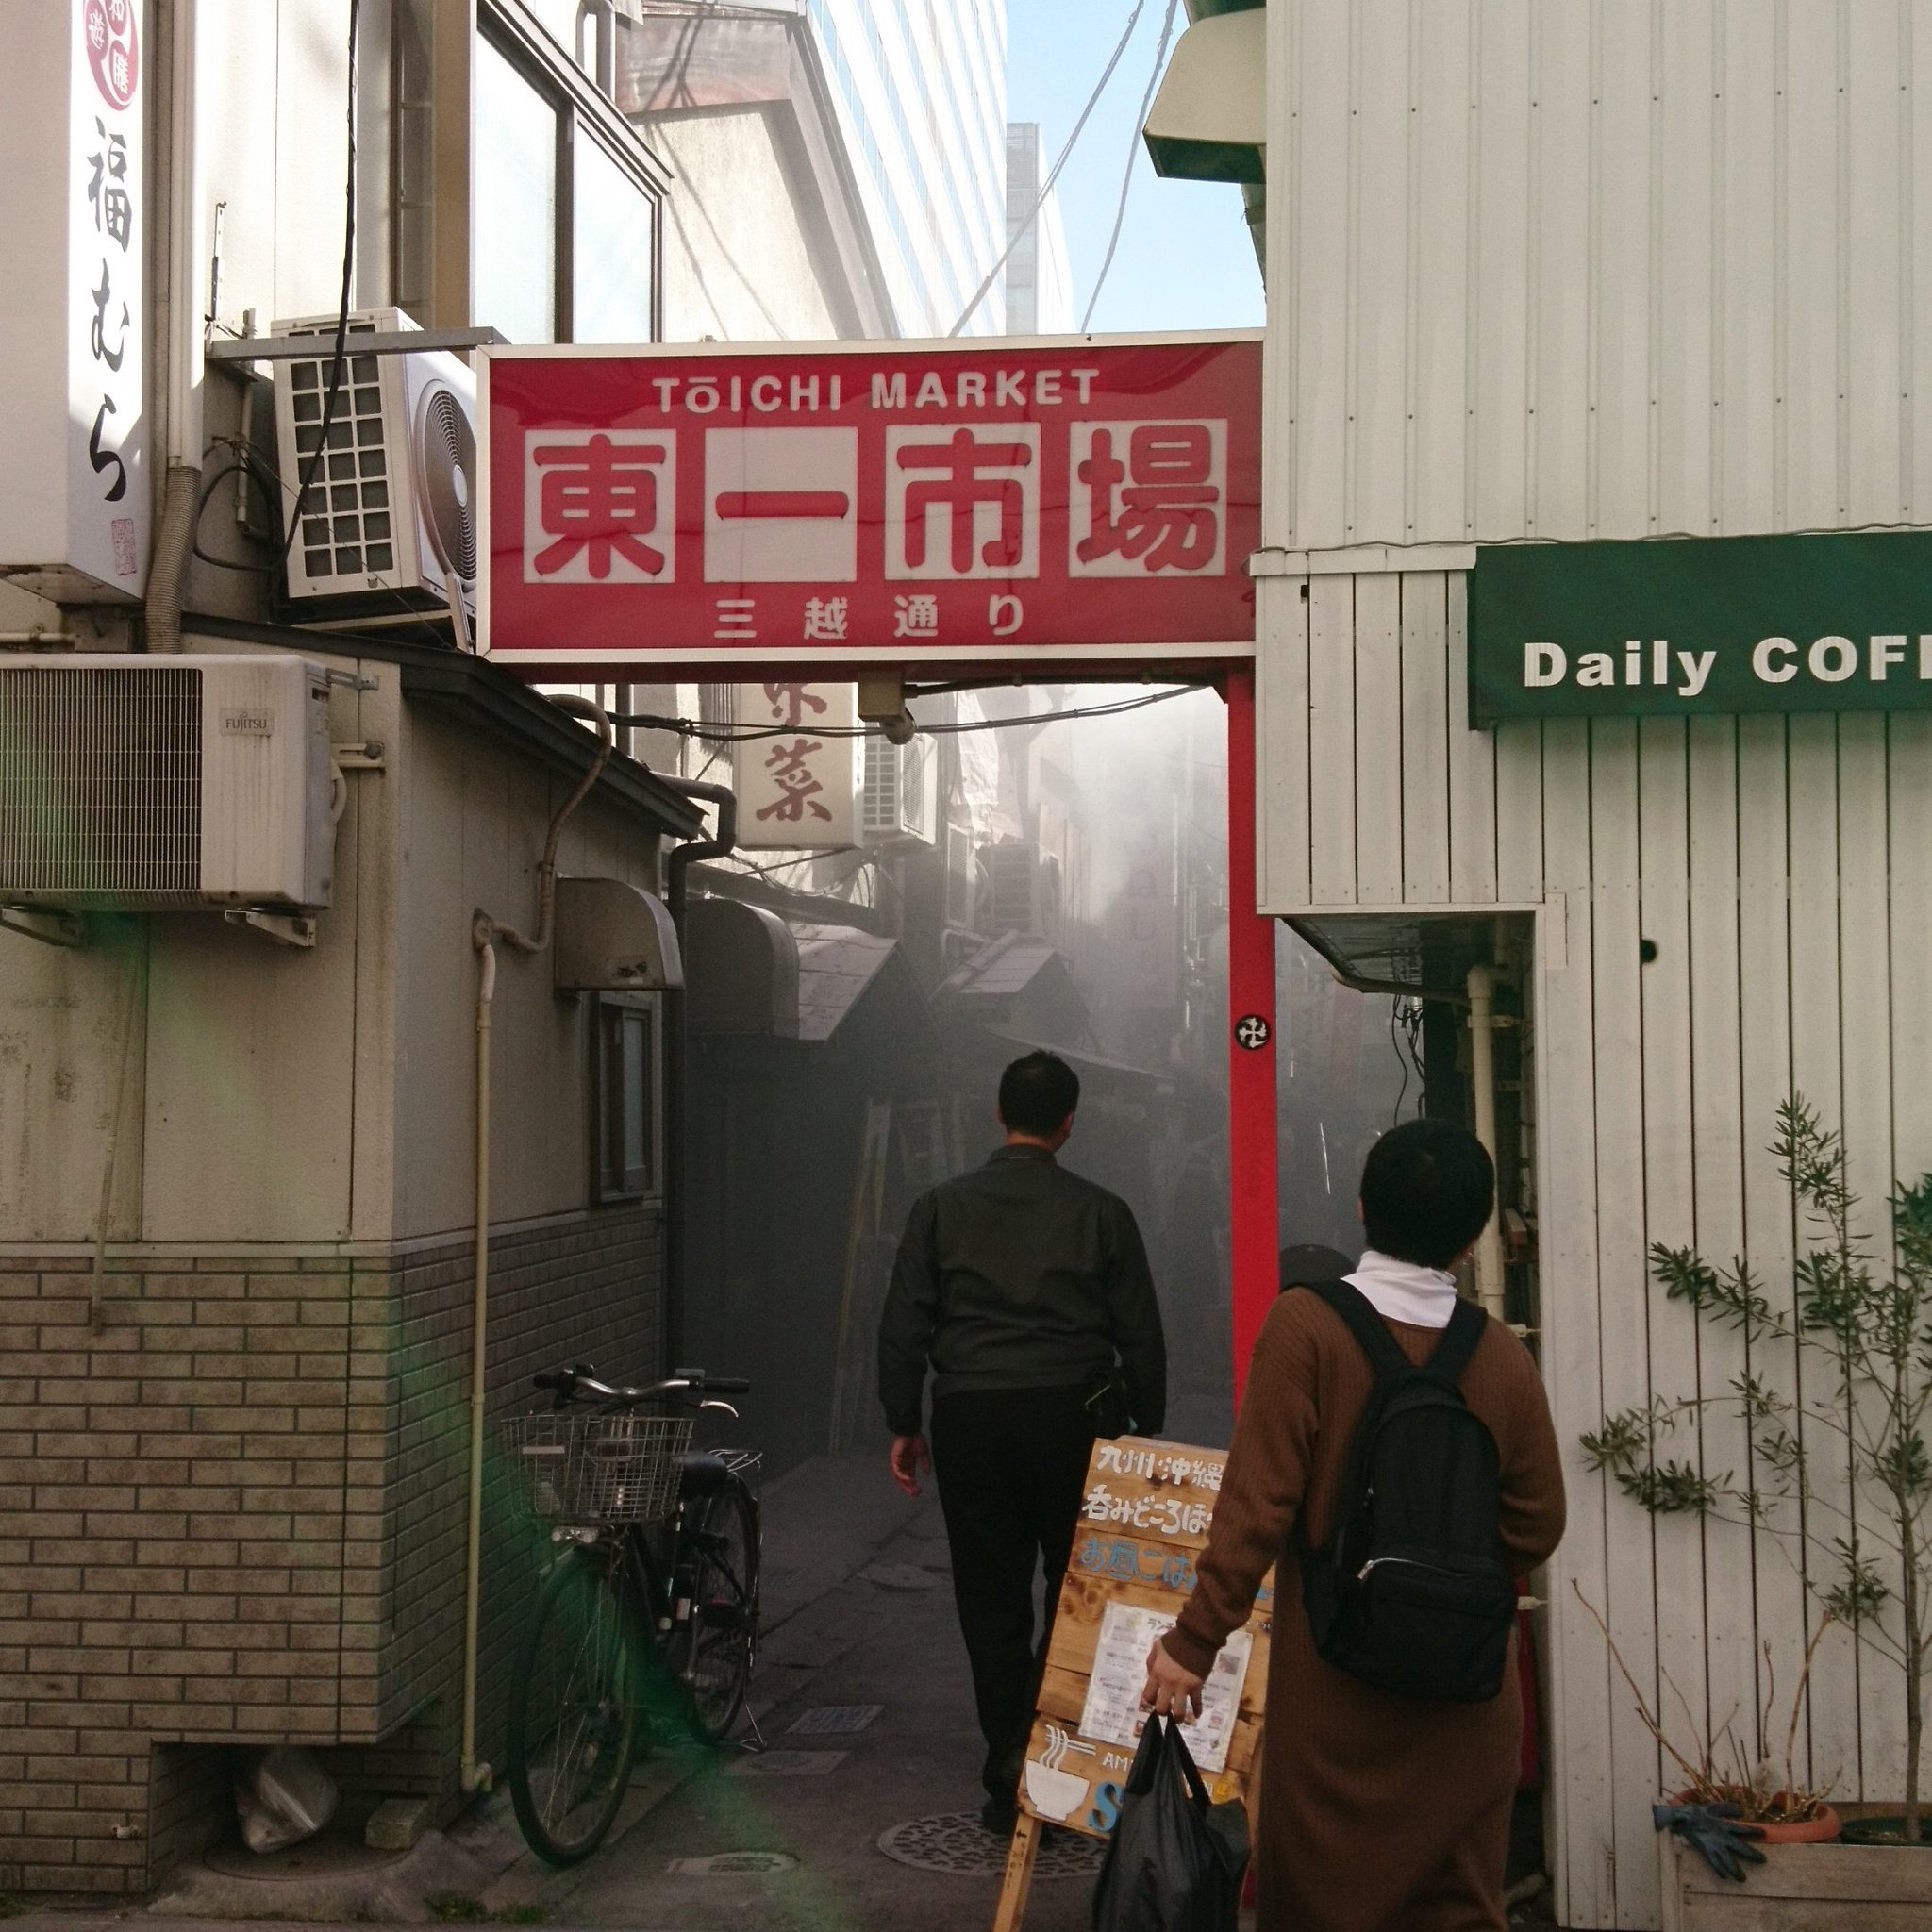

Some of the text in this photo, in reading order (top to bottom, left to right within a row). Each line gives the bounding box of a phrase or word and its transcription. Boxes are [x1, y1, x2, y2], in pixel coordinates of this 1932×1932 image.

[86, 115, 133, 502] 福むら
[871, 368, 1100, 409] MARKET
[531, 424, 1221, 578] 東一市場
[713, 593, 1024, 640] 三越通り
[1524, 640, 1717, 697] Daily
[226, 715, 267, 730] FUJITSU
[1081, 1484, 1213, 1534] 呑みどころほ
